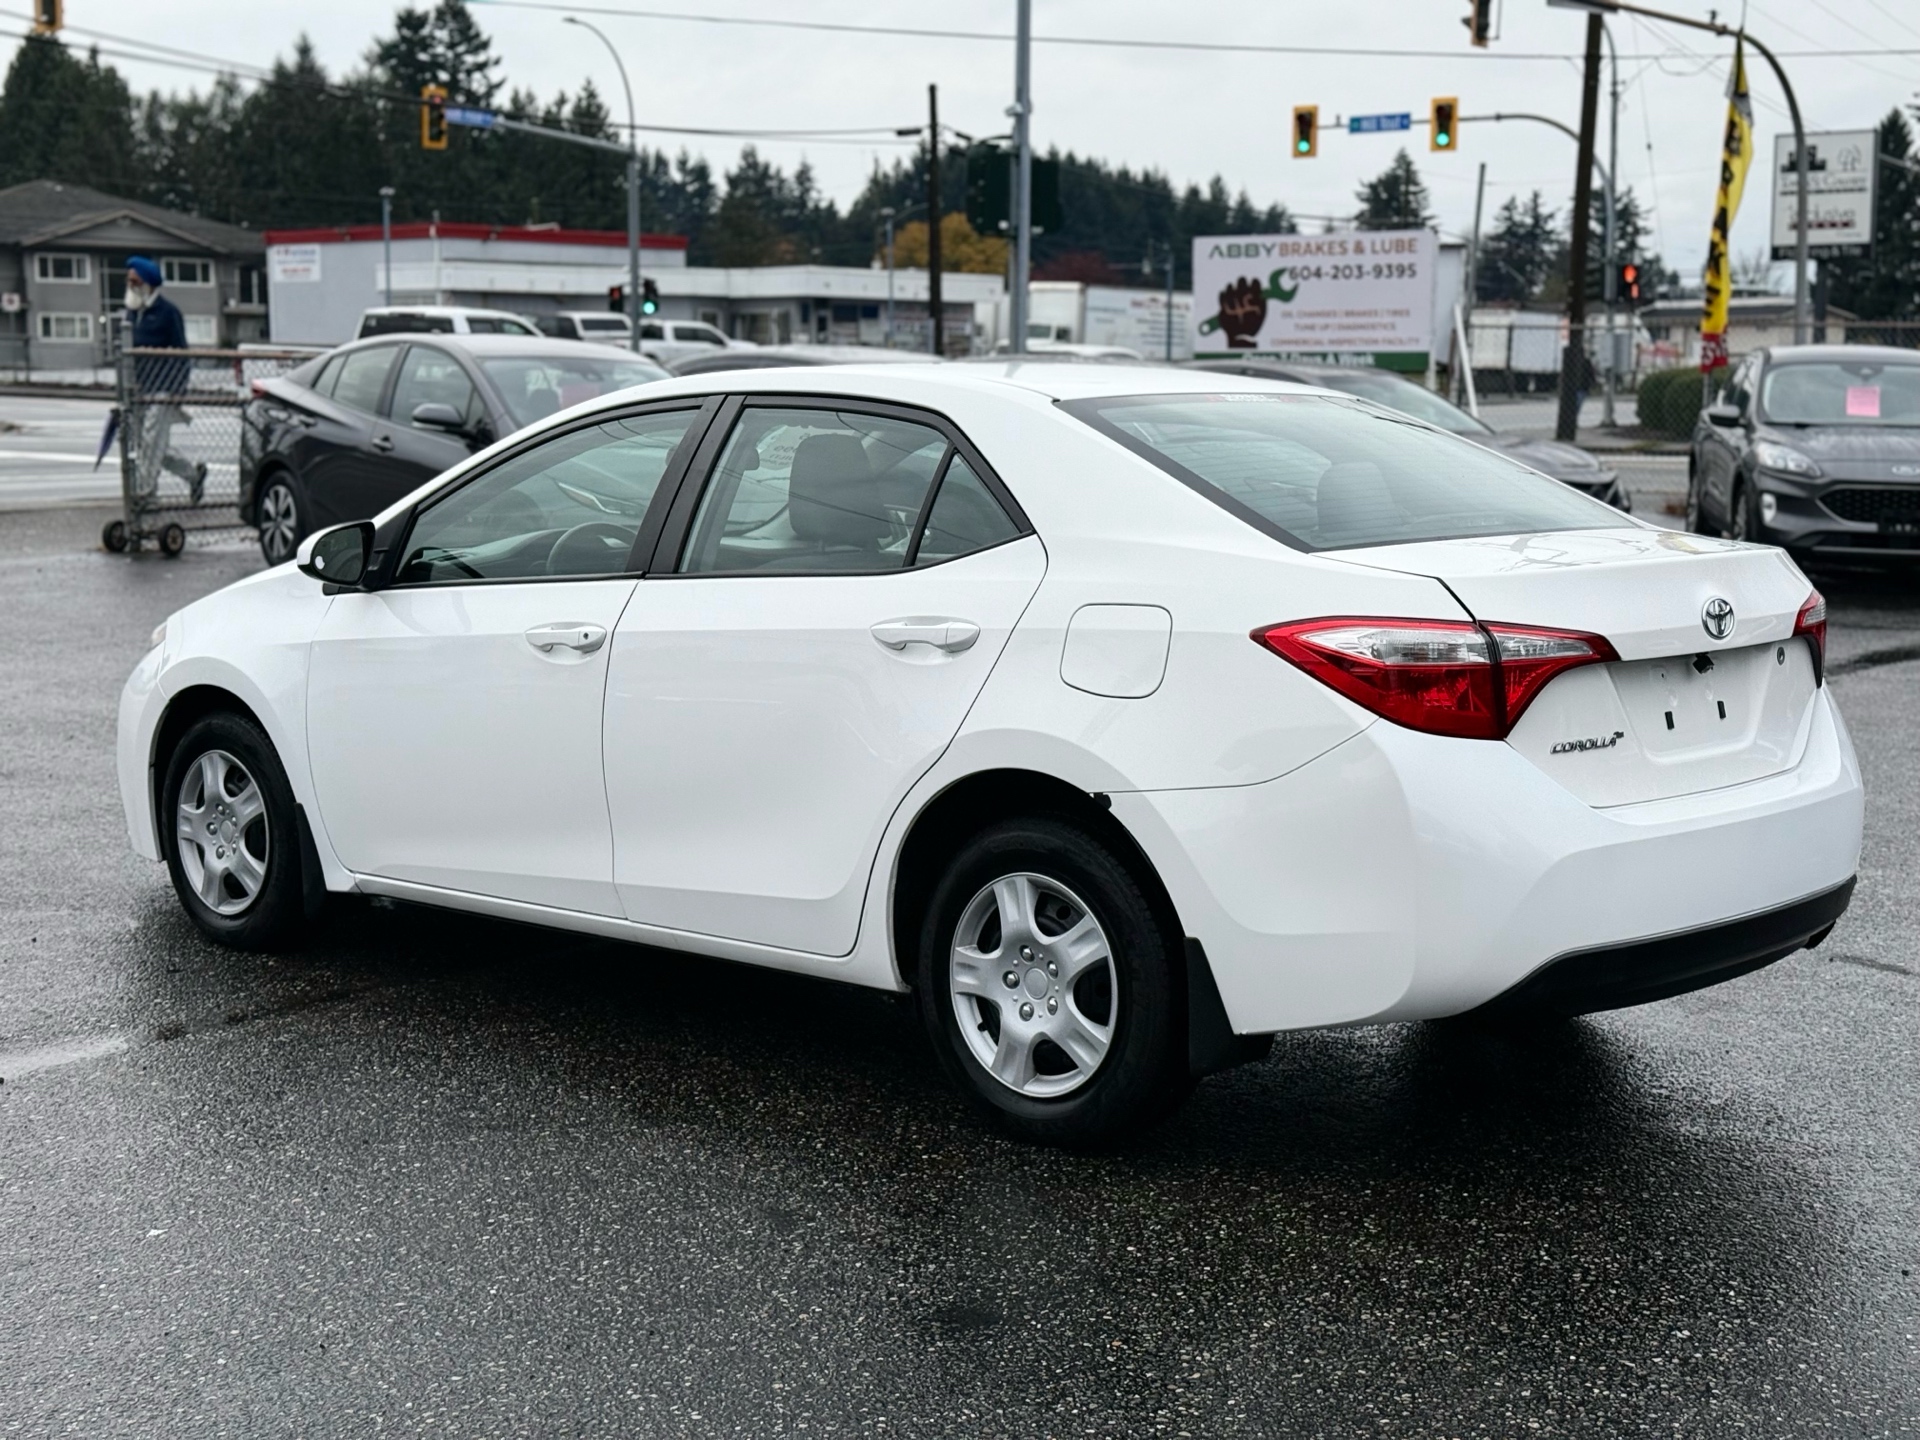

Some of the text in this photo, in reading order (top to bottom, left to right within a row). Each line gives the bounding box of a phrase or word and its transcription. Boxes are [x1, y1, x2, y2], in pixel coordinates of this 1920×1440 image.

[1209, 238, 1419, 259] ABBY BRAKES & LUBE
[1288, 263, 1418, 281] 604-203-9395
[1550, 736, 1617, 754] COROLLA
